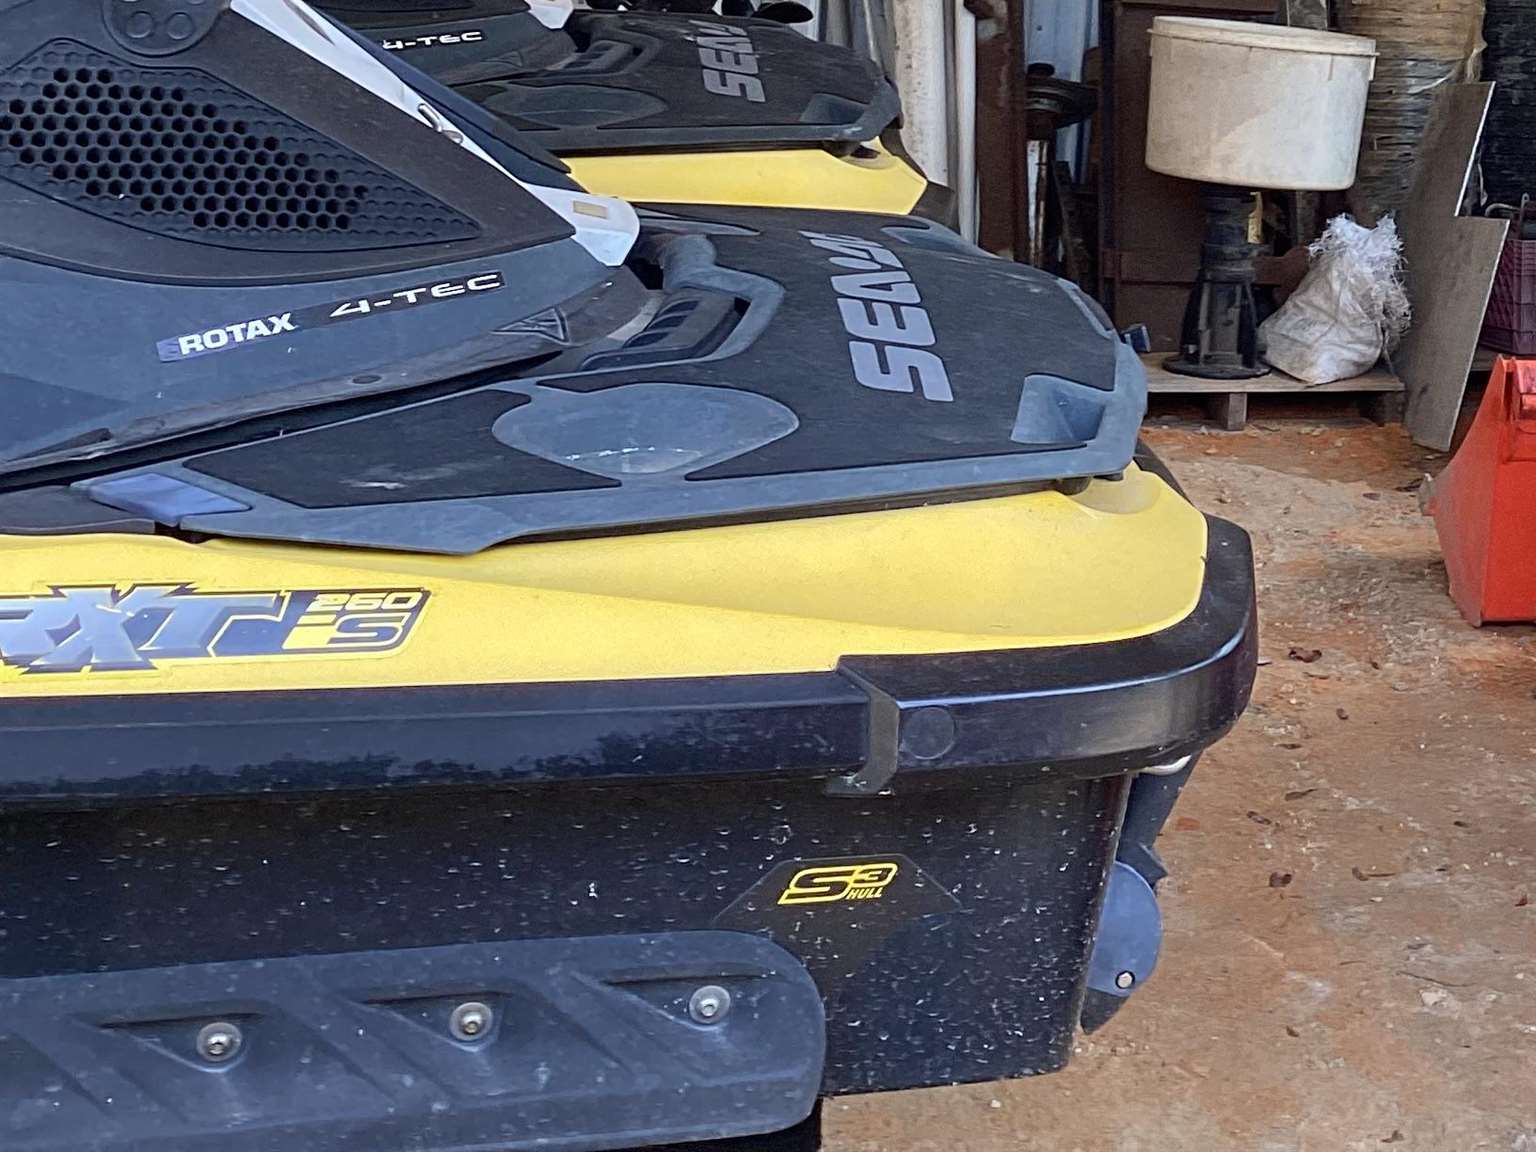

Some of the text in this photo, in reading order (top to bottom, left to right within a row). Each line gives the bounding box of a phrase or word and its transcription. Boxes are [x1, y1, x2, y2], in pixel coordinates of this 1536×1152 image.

[382, 31, 483, 50] 4-TEC
[178, 274, 501, 355] ROTAX 4-TEC
[305, 592, 423, 612] 260
[845, 887, 884, 900] HULL
